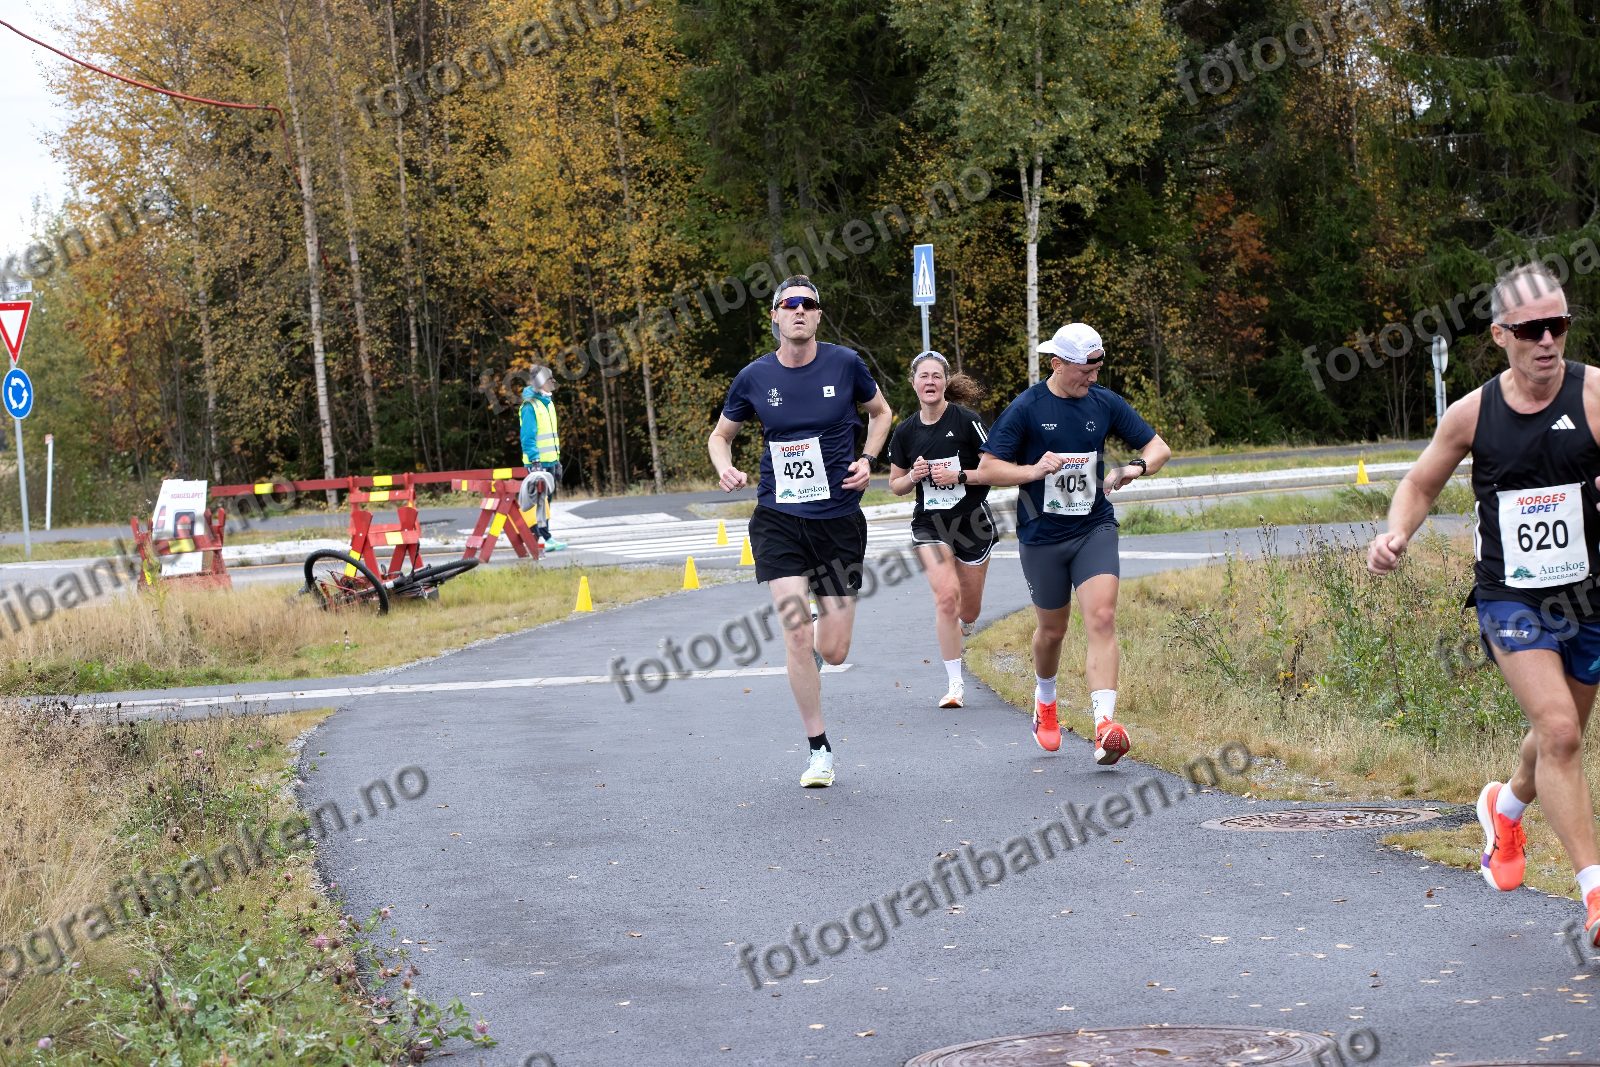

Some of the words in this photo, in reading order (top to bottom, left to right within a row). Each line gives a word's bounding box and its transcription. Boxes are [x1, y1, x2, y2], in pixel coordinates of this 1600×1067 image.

[780, 444, 810, 452] NORGES
[784, 461, 815, 479] 423
[1055, 474, 1087, 493] 405
[1516, 492, 1567, 506] NORGES
[1521, 503, 1559, 515] LØPET
[1517, 519, 1569, 553] 620
[1539, 561, 1586, 575] Aurskog
